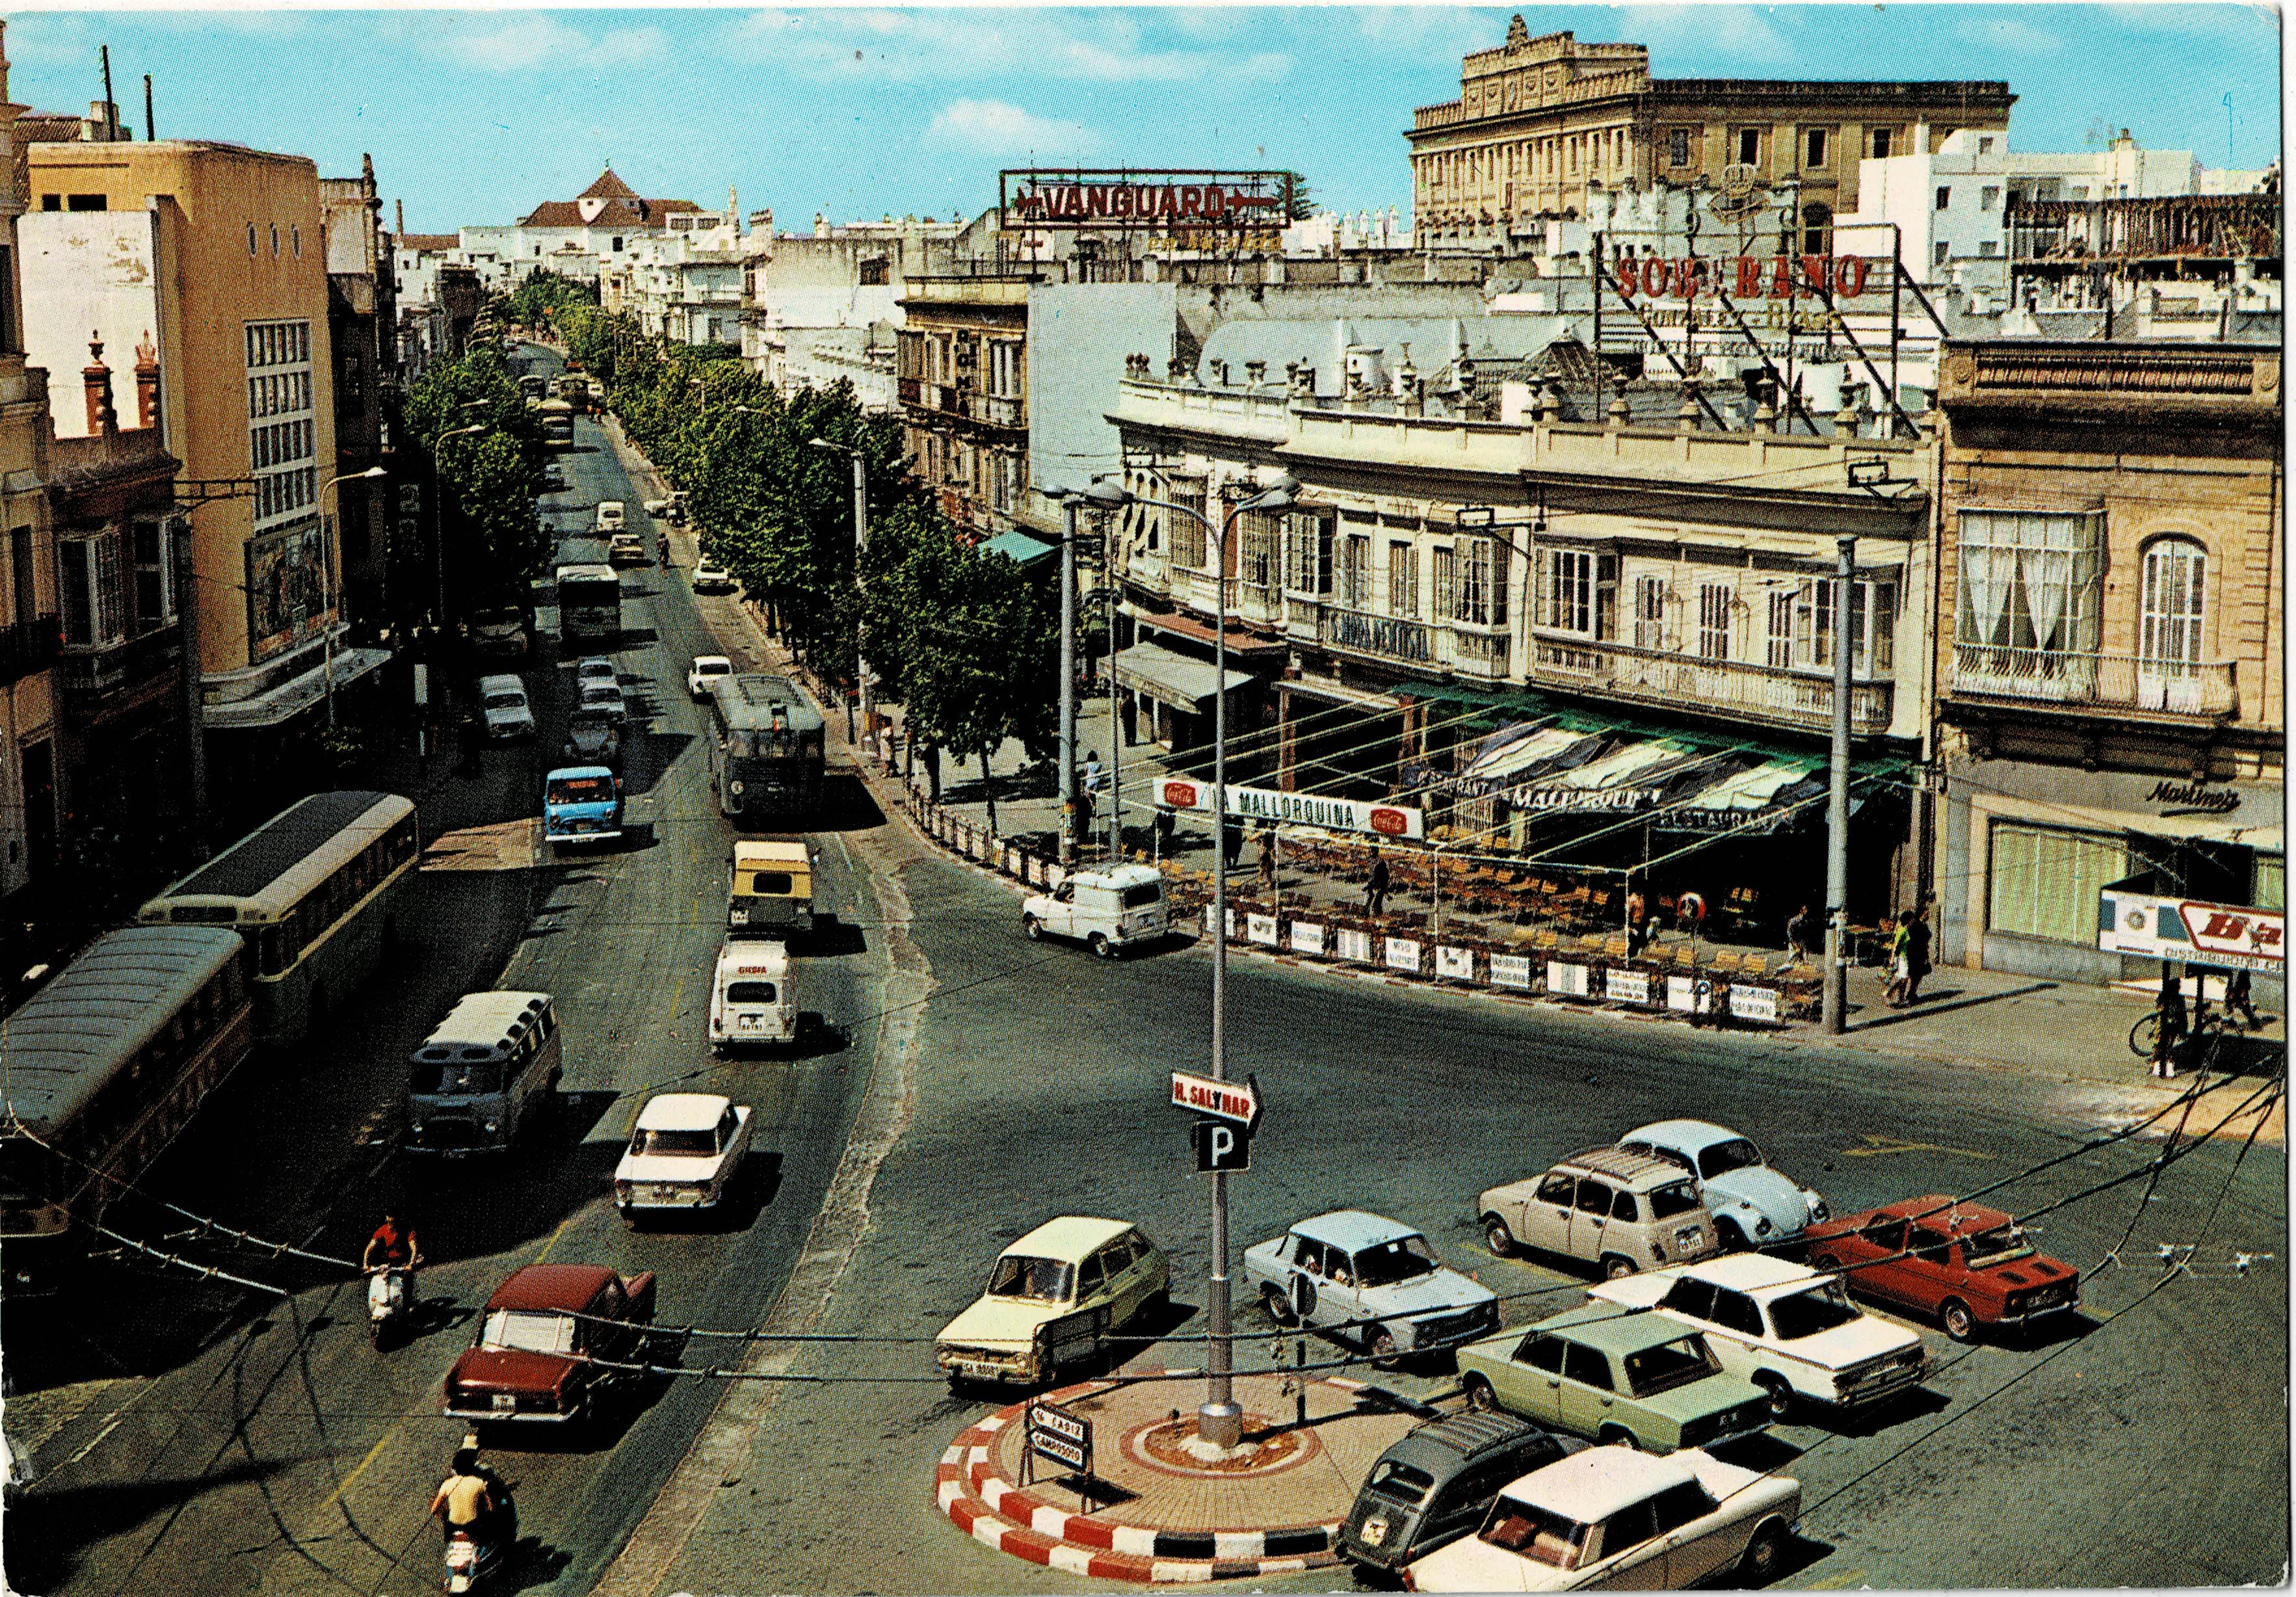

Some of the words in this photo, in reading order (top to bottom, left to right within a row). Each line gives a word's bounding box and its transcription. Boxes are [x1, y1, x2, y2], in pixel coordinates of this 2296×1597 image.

[1042, 185, 1226, 218] VANGUARD
[1239, 791, 1355, 827] MALLORQUINA
[1174, 1081, 1187, 1103] H.
[1211, 1126, 1234, 1167] P
[1051, 1416, 1081, 1437] CADIZ
